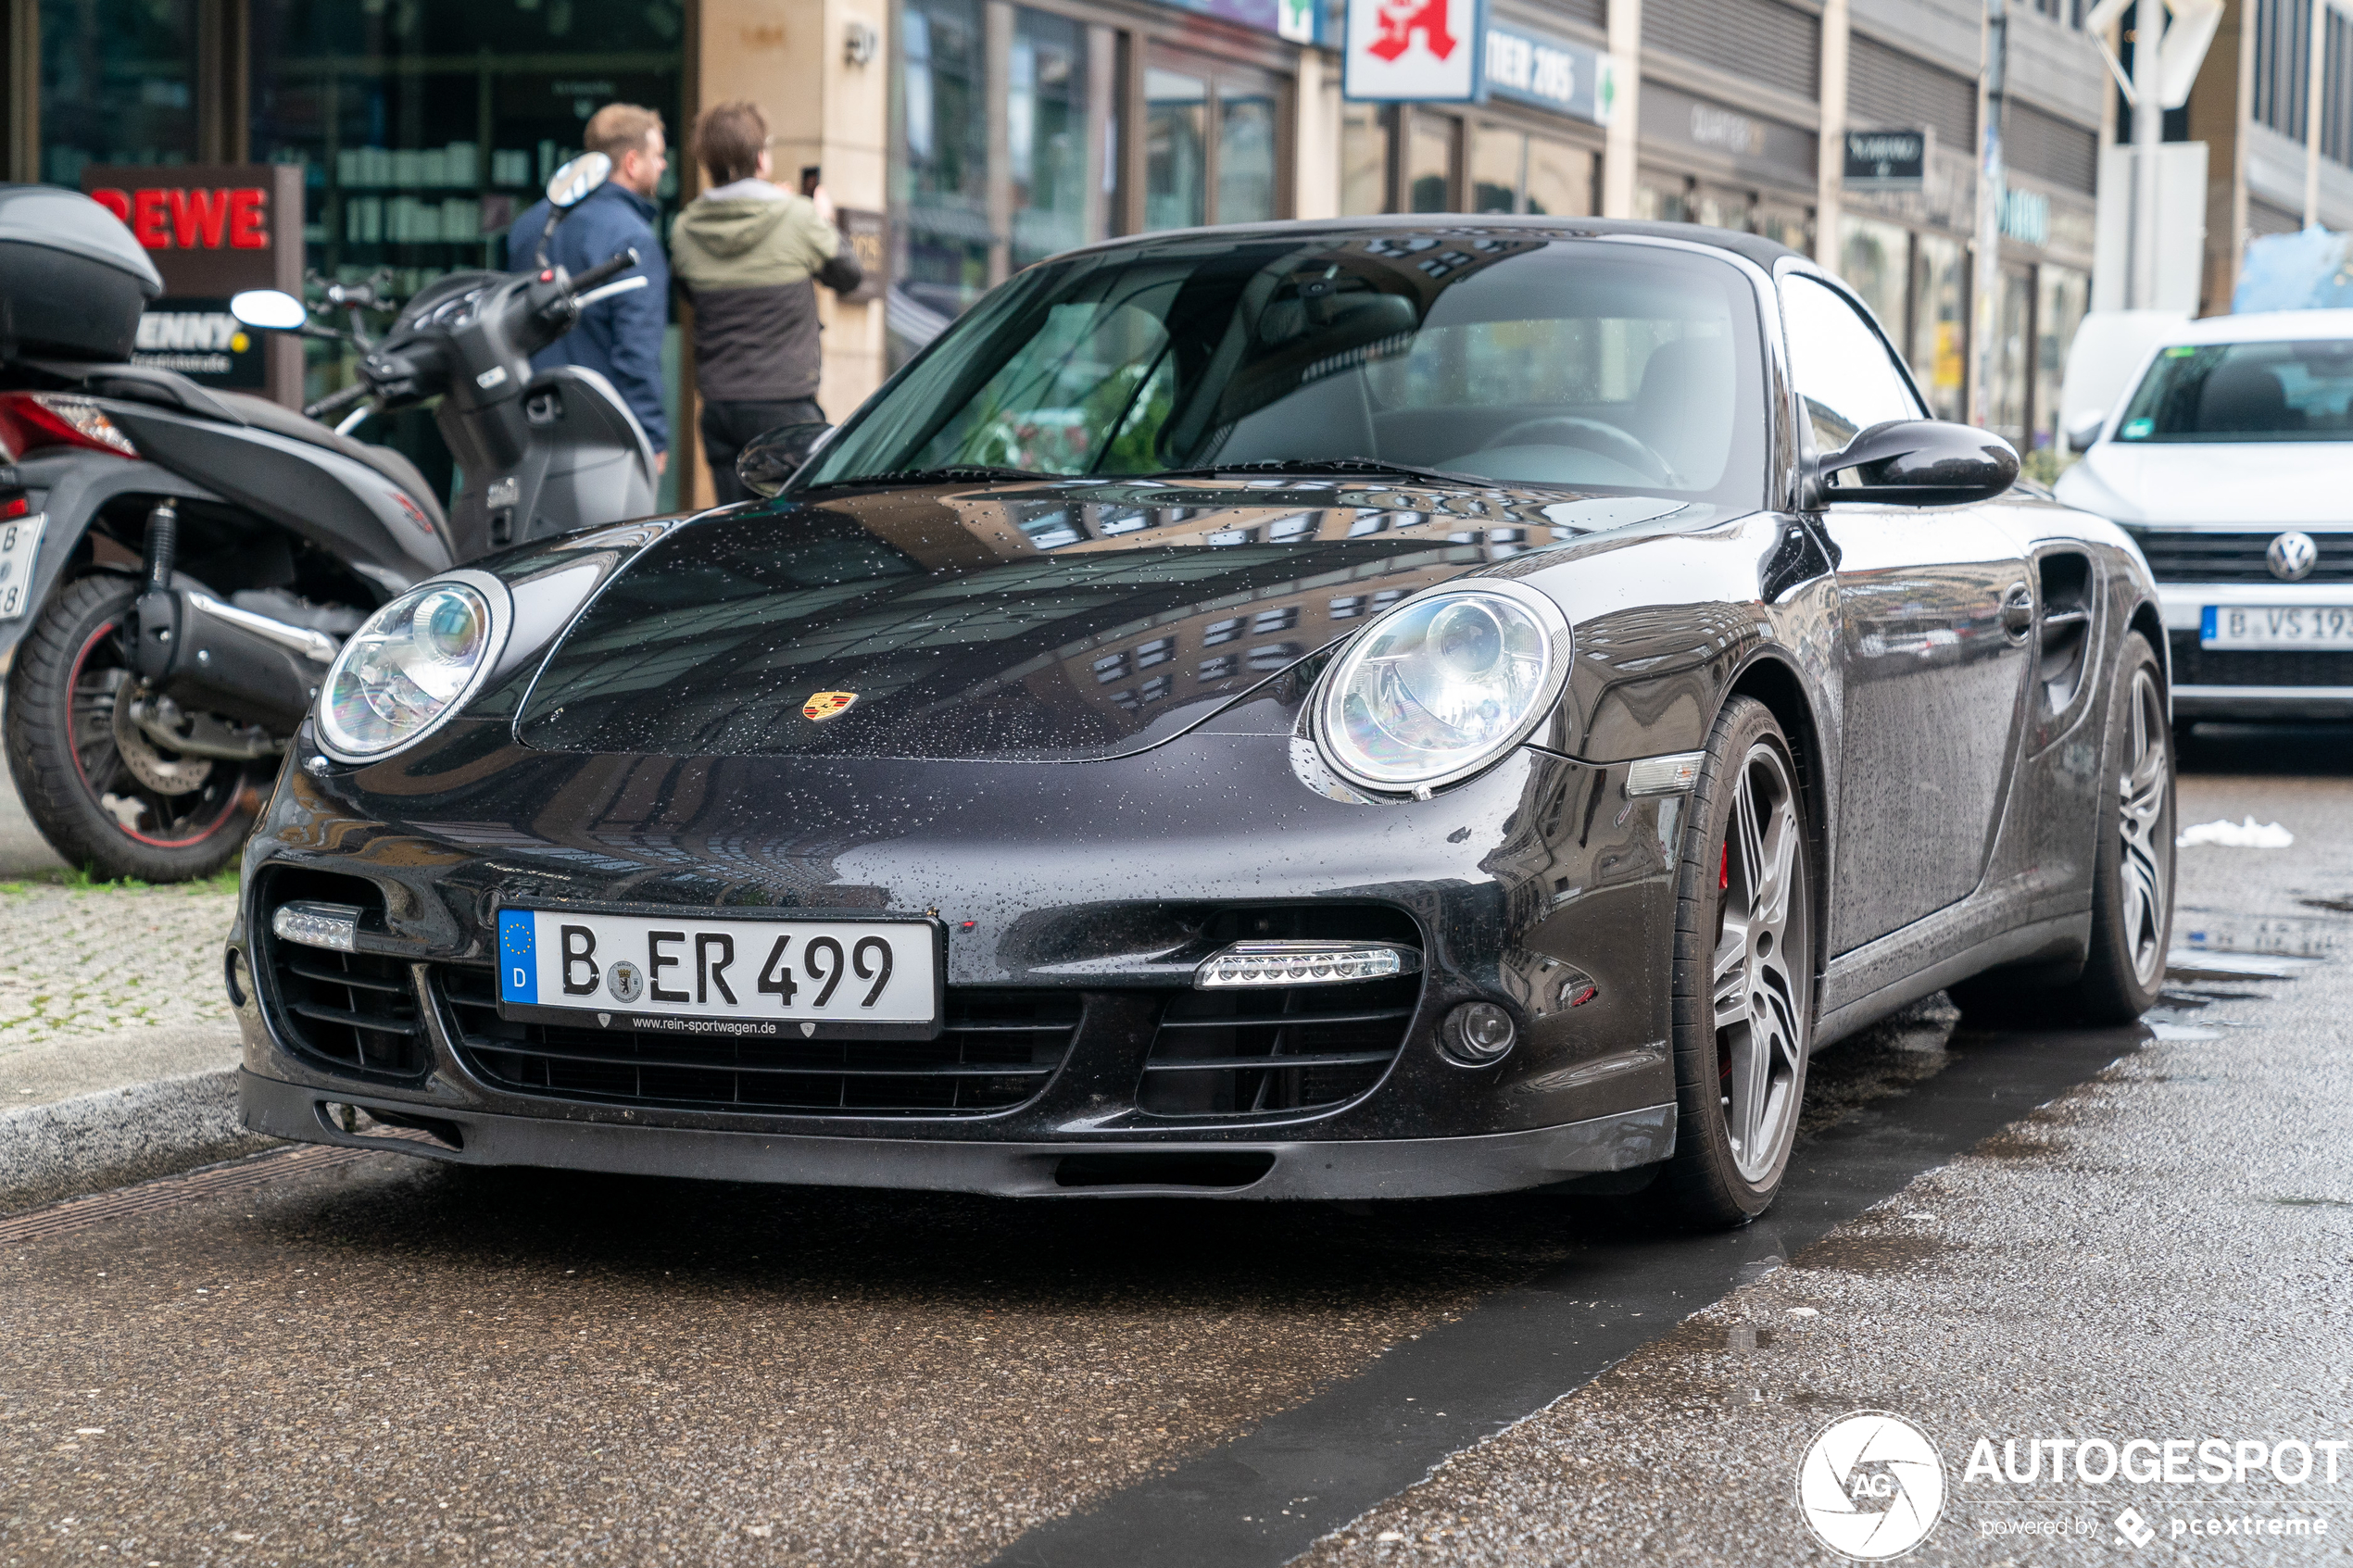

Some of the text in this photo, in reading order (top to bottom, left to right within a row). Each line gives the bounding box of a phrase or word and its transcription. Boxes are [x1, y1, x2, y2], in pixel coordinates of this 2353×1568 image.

[1534, 46, 1574, 102] 205
[4, 527, 18, 551] B
[0, 586, 18, 612] 8
[2229, 607, 2246, 637] B
[2268, 608, 2302, 637] VS
[514, 968, 525, 987] D
[560, 924, 894, 1007] B ER 499
[633, 1018, 776, 1035] www.rein-sportwagen.de
